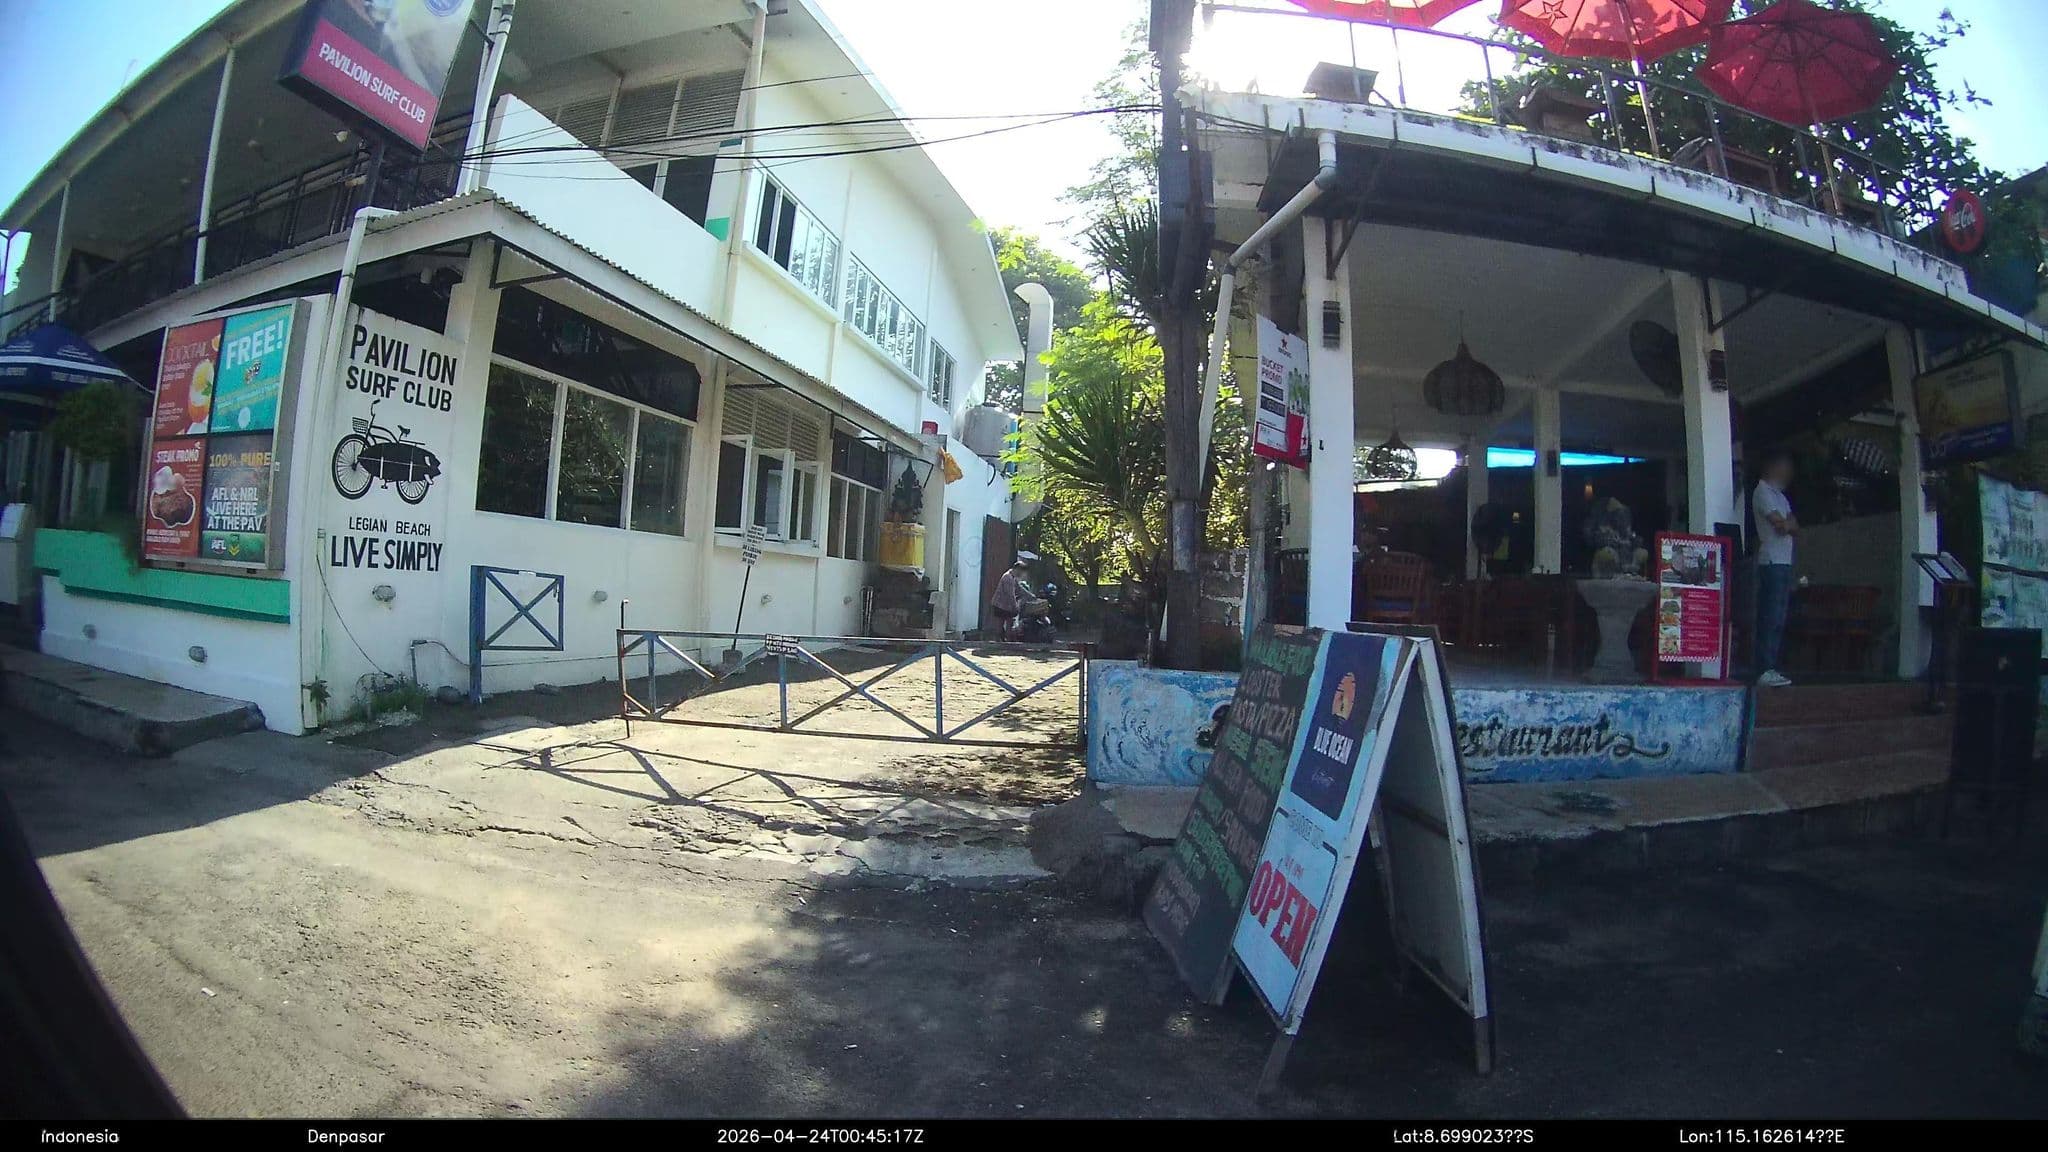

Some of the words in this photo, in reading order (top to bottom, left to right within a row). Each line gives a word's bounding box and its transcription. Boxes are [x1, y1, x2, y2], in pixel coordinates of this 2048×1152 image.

[318, 42, 372, 87] PAVILION
[369, 77, 400, 105] SURF
[398, 96, 426, 124] CLUB
[226, 319, 284, 370] FREE!
[350, 323, 457, 386] PAVILION
[346, 366, 399, 399] SURF
[403, 380, 452, 412] CLUB
[209, 453, 237, 467] 100%
[211, 487, 228, 501] AFL
[230, 487, 240, 501] &
[240, 487, 258, 501] NRL
[212, 502, 232, 515] LIVE
[233, 502, 257, 516] HERE
[207, 516, 222, 529] AT
[223, 516, 240, 530] THE
[241, 517, 262, 531] PAV
[349, 516, 388, 533] LEGIAN
[396, 521, 431, 537] BEACH
[331, 535, 379, 569] LIVE
[384, 538, 443, 572] SIMPLY
[1327, 733, 1354, 765] OCEAN
[1250, 860, 1318, 970] OPEN
